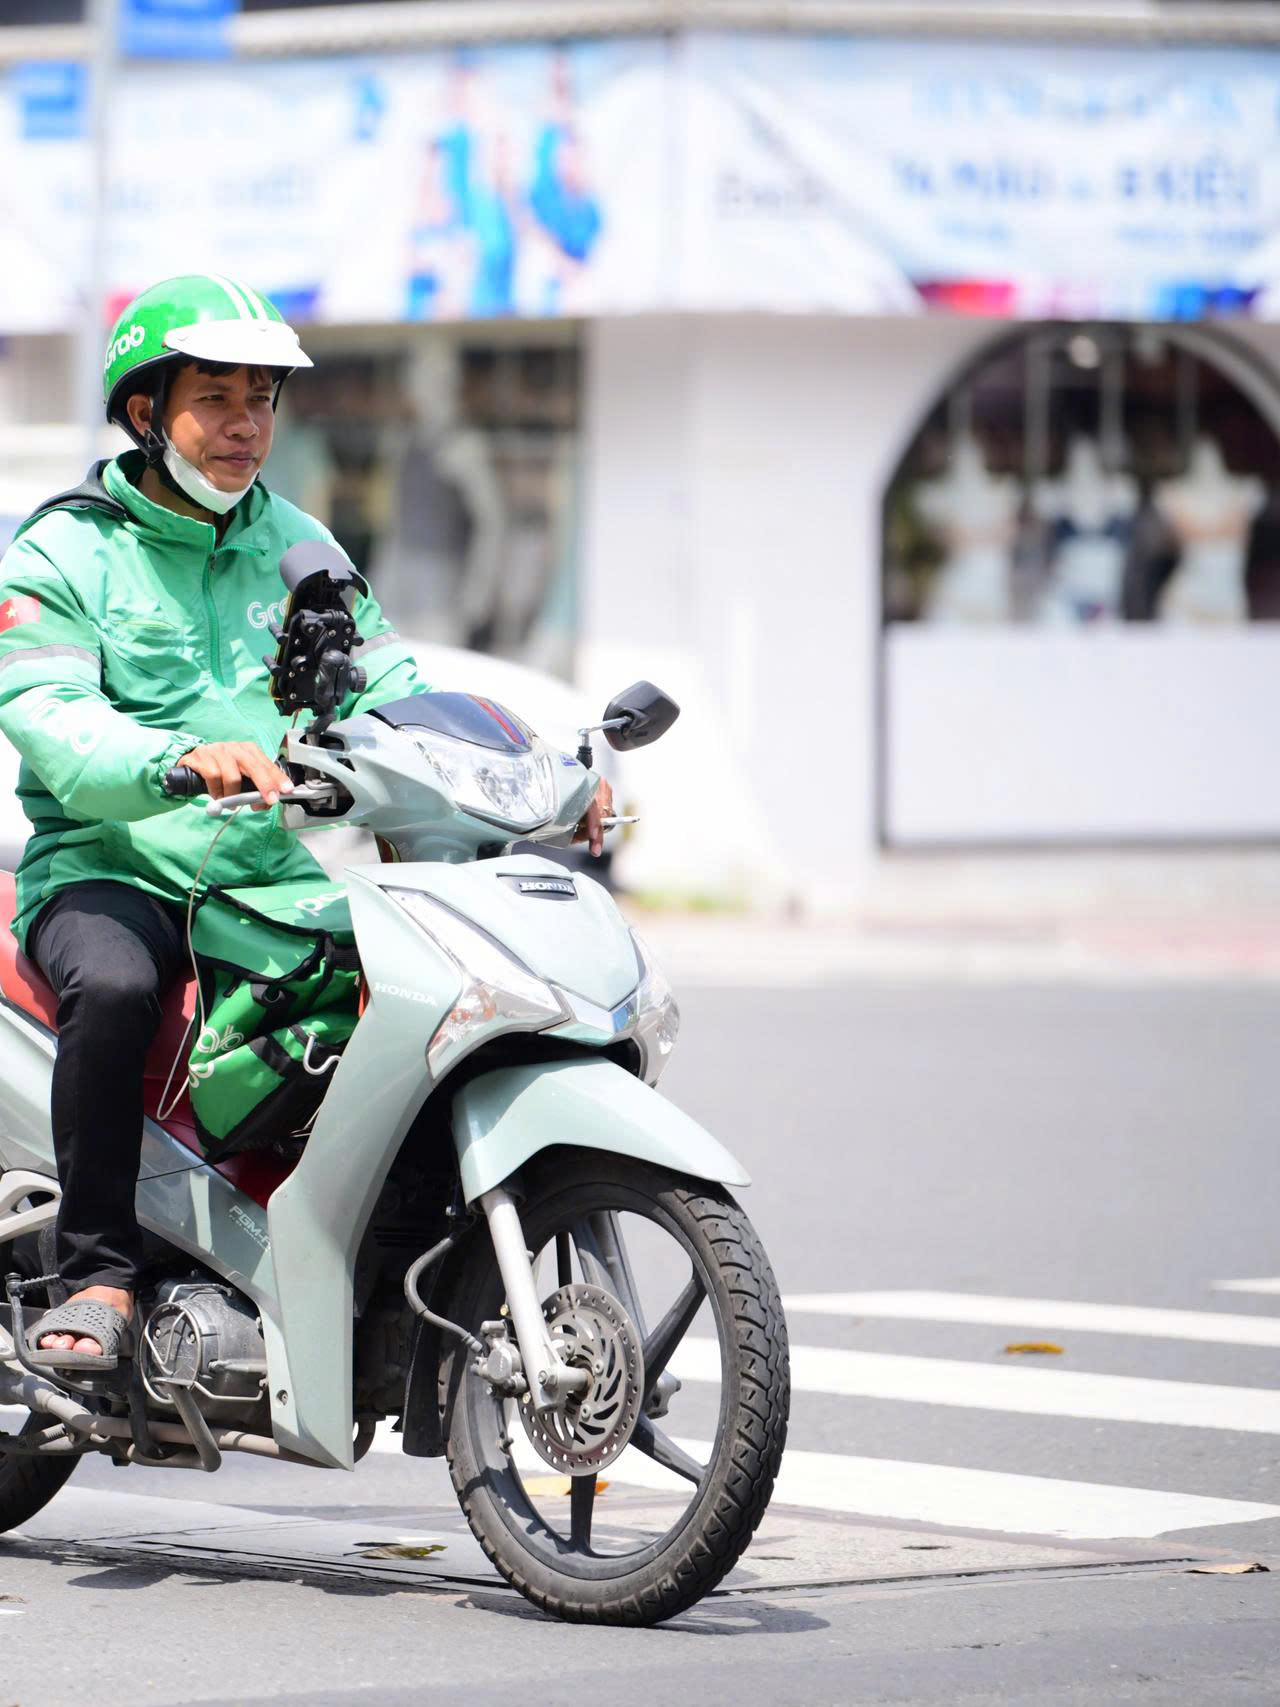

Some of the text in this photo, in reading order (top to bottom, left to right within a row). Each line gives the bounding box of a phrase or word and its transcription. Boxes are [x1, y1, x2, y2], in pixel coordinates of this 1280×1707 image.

[247, 597, 289, 629] Gr
[519, 881, 575, 895] HONDA
[374, 982, 439, 1009] HONDA
[228, 1204, 272, 1250] PGM-F
